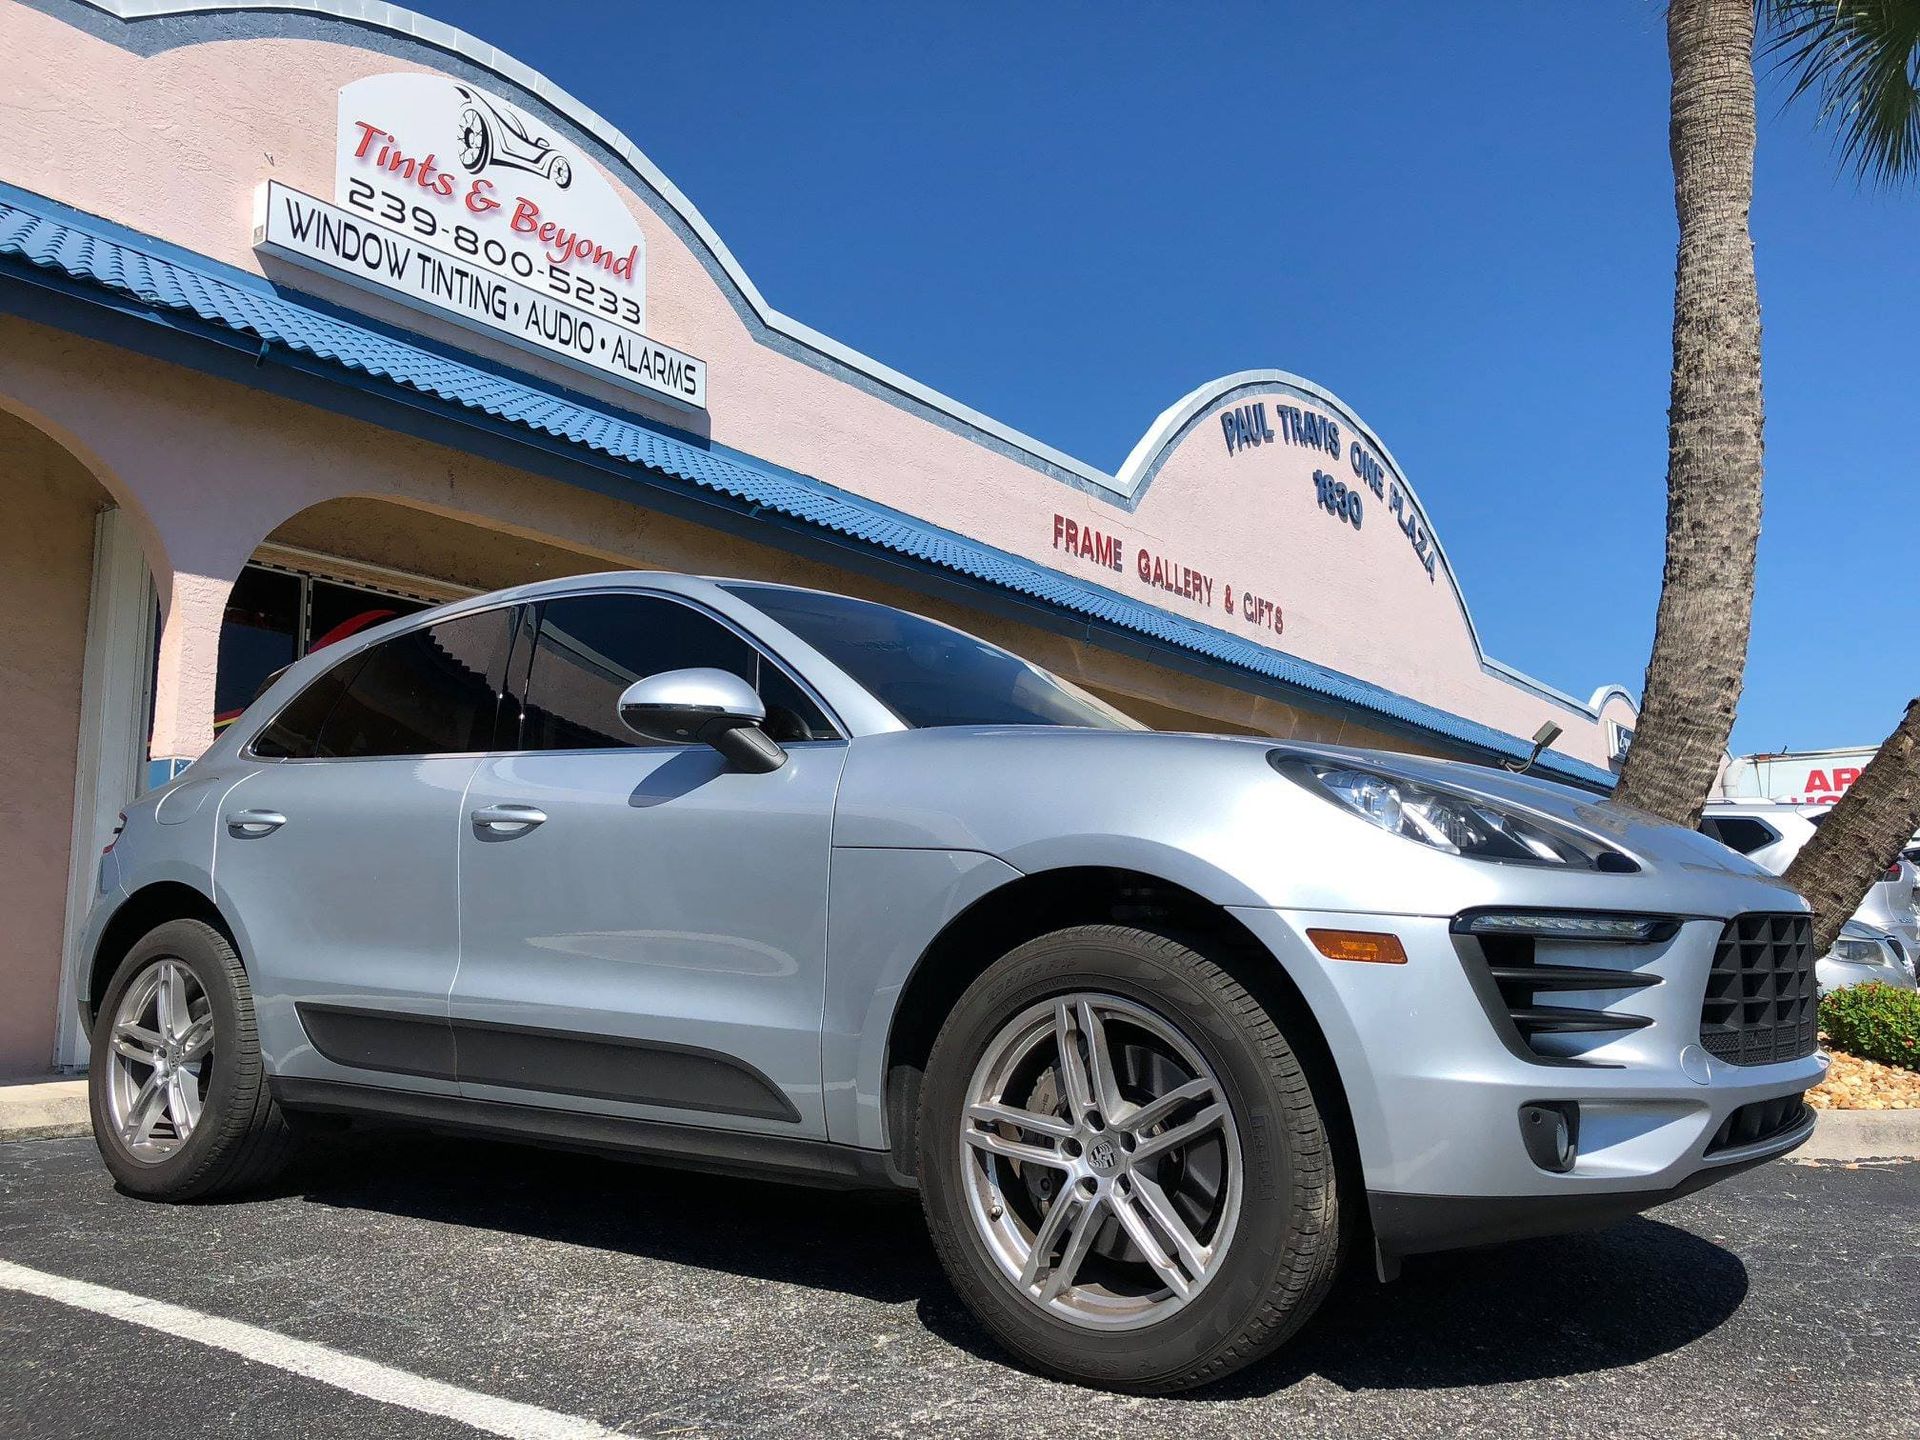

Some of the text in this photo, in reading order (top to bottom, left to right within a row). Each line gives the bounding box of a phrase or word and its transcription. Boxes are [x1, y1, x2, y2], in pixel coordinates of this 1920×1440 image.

[349, 177, 642, 325] 239-800-5233
[355, 121, 638, 280] Tints & Beyond
[286, 197, 697, 395] WINDOW TINTING AUDIO ALARMS
[1221, 403, 1436, 584] PAUL TRAVIS ONE PLAZA
[1313, 469, 1364, 531] 1830
[1053, 513, 1284, 635] FRAME GALLERY & GIFTS
